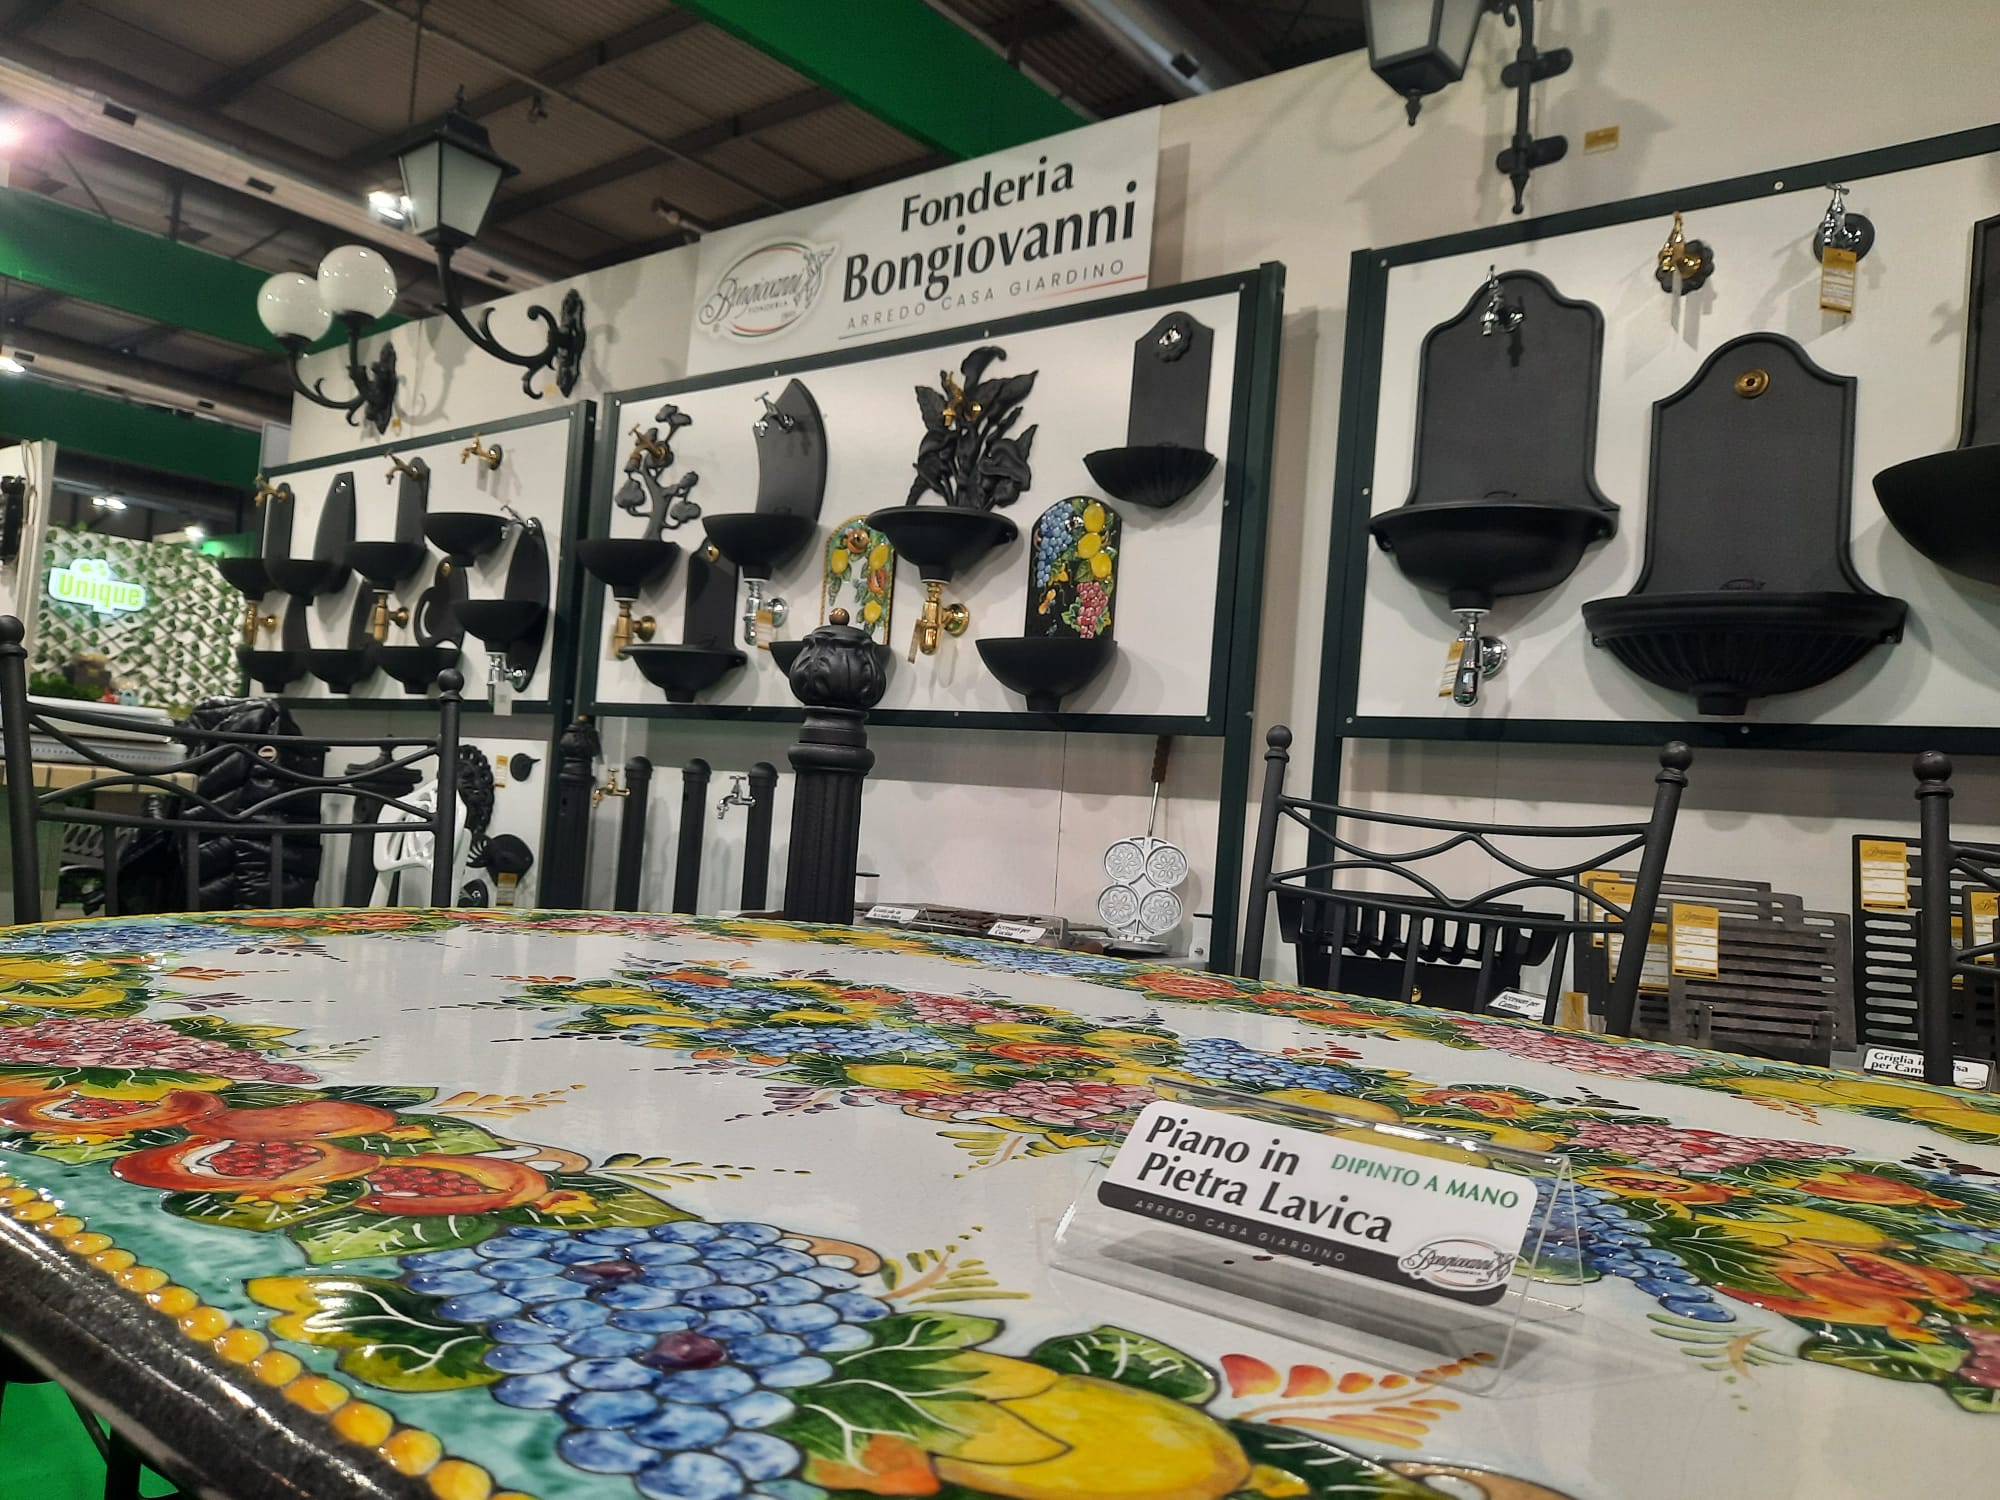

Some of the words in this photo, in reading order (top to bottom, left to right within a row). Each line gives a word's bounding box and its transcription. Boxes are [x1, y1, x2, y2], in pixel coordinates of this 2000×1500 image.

[901, 156, 1074, 232] Fonderia
[843, 181, 1138, 302] Bongiovanni
[847, 302, 927, 331] ARREDO
[941, 288, 995, 312] CASA
[1009, 259, 1125, 297] GIARDINO
[58, 573, 143, 609] Unique
[1871, 1061, 1890, 1072] per
[1874, 1051, 1914, 1066] Griglia
[1144, 1115, 1251, 1165] Piano
[1259, 1138, 1299, 1176] in
[1136, 1151, 1248, 1206] Pietra
[1259, 1180, 1393, 1243] Lavica
[1331, 1153, 1421, 1188] DIPINTO
[1424, 1176, 1439, 1192] A
[1446, 1180, 1520, 1209] MANO
[1134, 1199, 1197, 1222] ARREDO
[1204, 1217, 1248, 1237] CASA
[1257, 1232, 1346, 1262] GIARDINO
